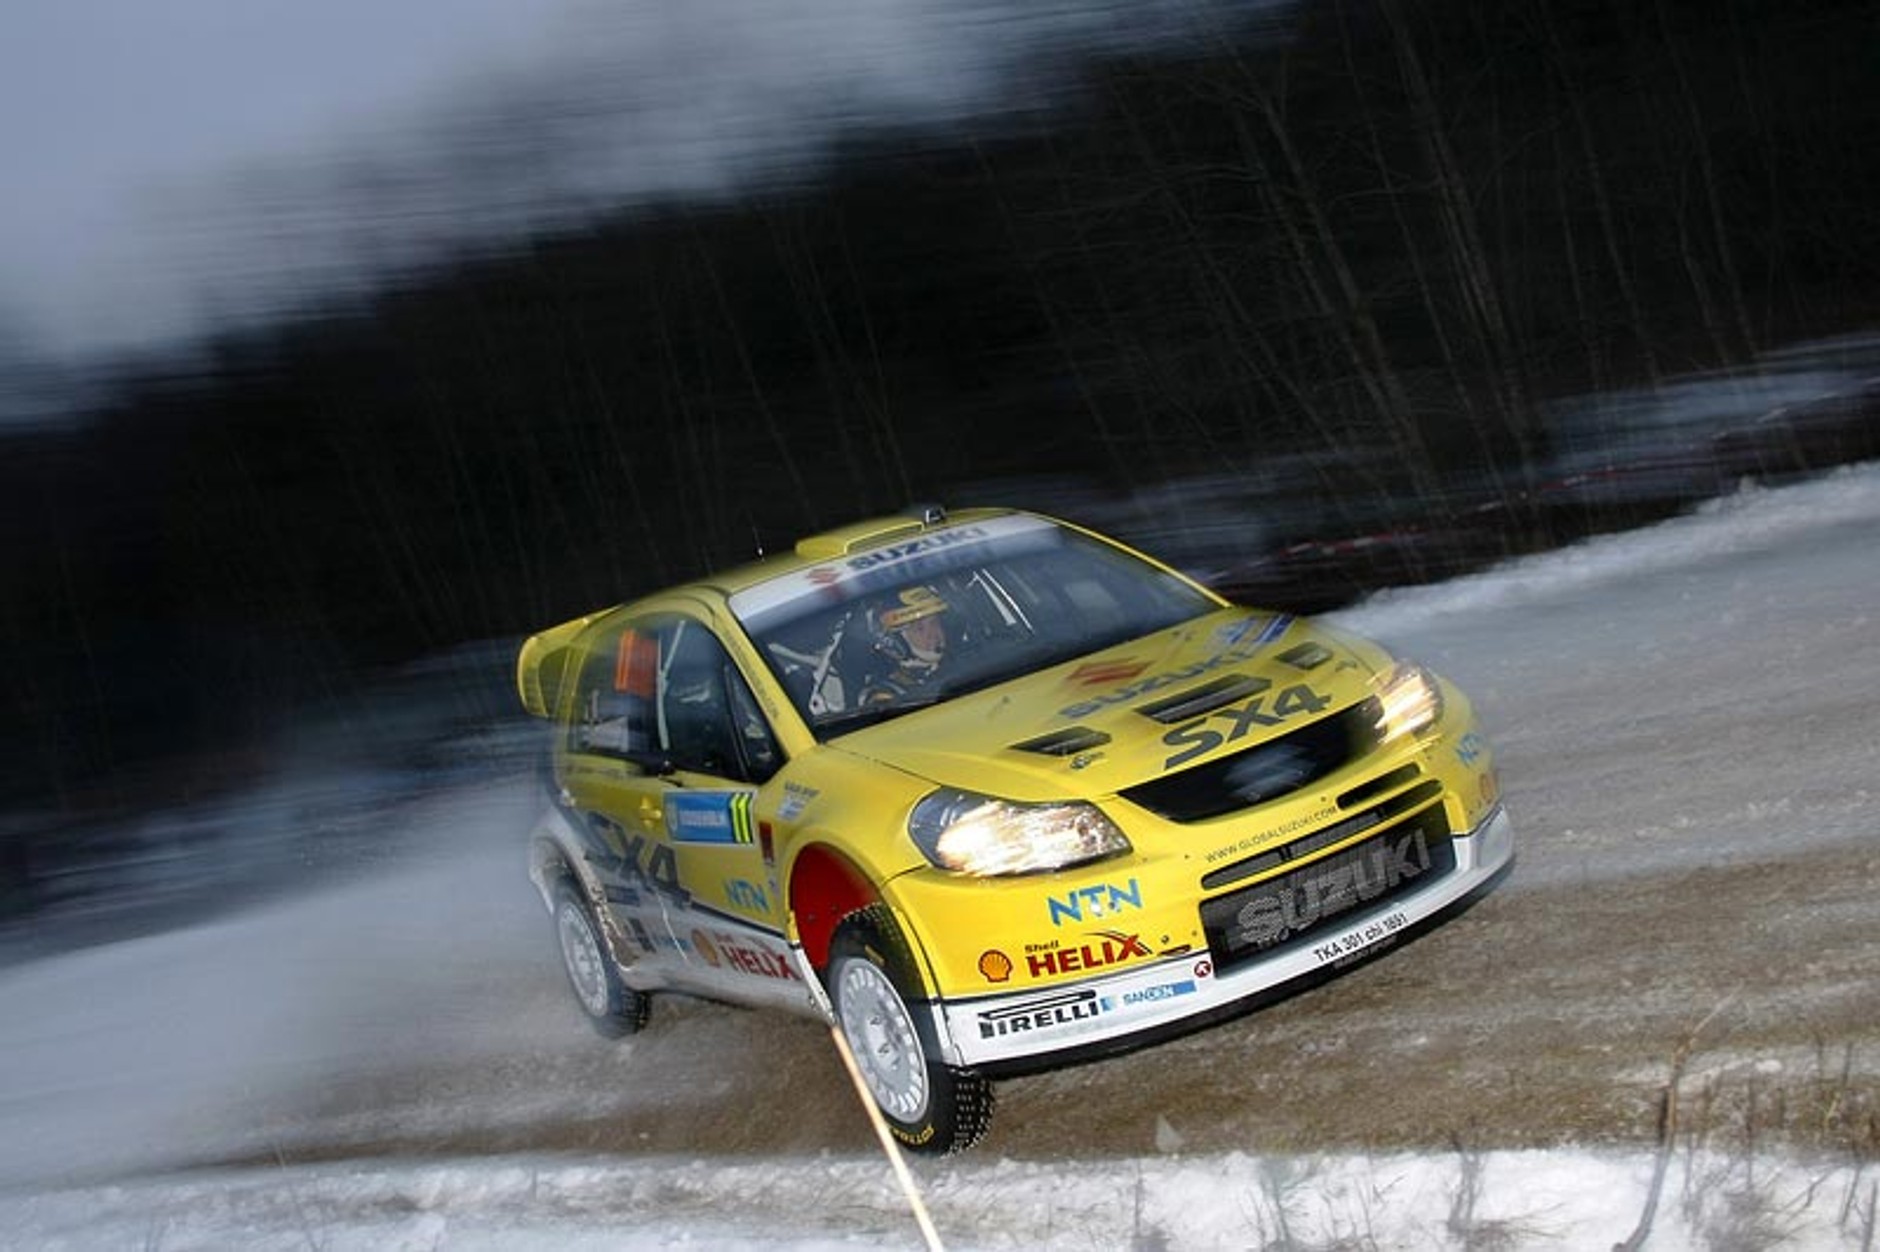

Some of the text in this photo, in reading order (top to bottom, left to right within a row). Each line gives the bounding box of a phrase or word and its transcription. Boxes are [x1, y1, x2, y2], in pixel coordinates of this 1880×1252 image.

[846, 527, 988, 569] SUZUKI
[1162, 683, 1332, 771] SX4
[1047, 879, 1142, 926] NTN
[1238, 827, 1431, 946] SUZUKI
[1024, 930, 1152, 978] HELIX
[1025, 939, 1060, 953] Shell
[1313, 942, 1343, 962] TKA
[1342, 932, 1364, 950] 301
[977, 989, 1098, 1039] PIRELLI
